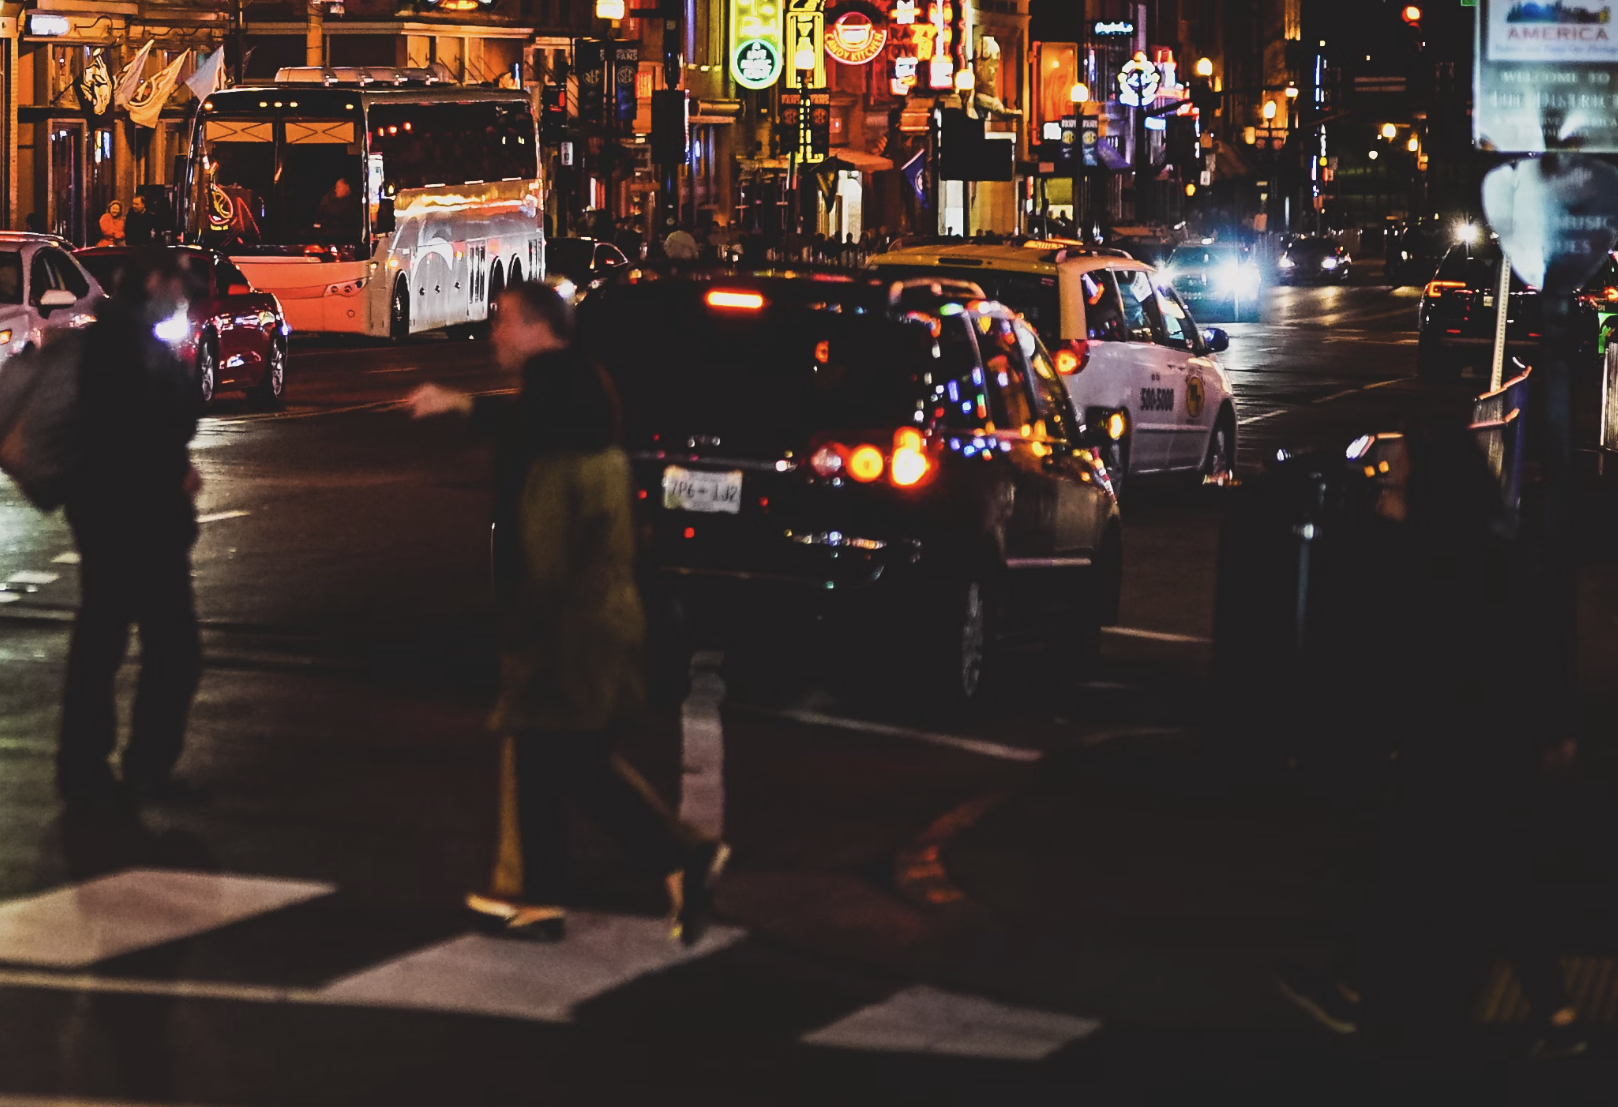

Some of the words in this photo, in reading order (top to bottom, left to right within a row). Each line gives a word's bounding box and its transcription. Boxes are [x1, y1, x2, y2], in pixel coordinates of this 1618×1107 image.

[1508, 26, 1609, 41] AMERICA
[825, 33, 850, 61] CANDY
[850, 34, 884, 62] KITCHEN
